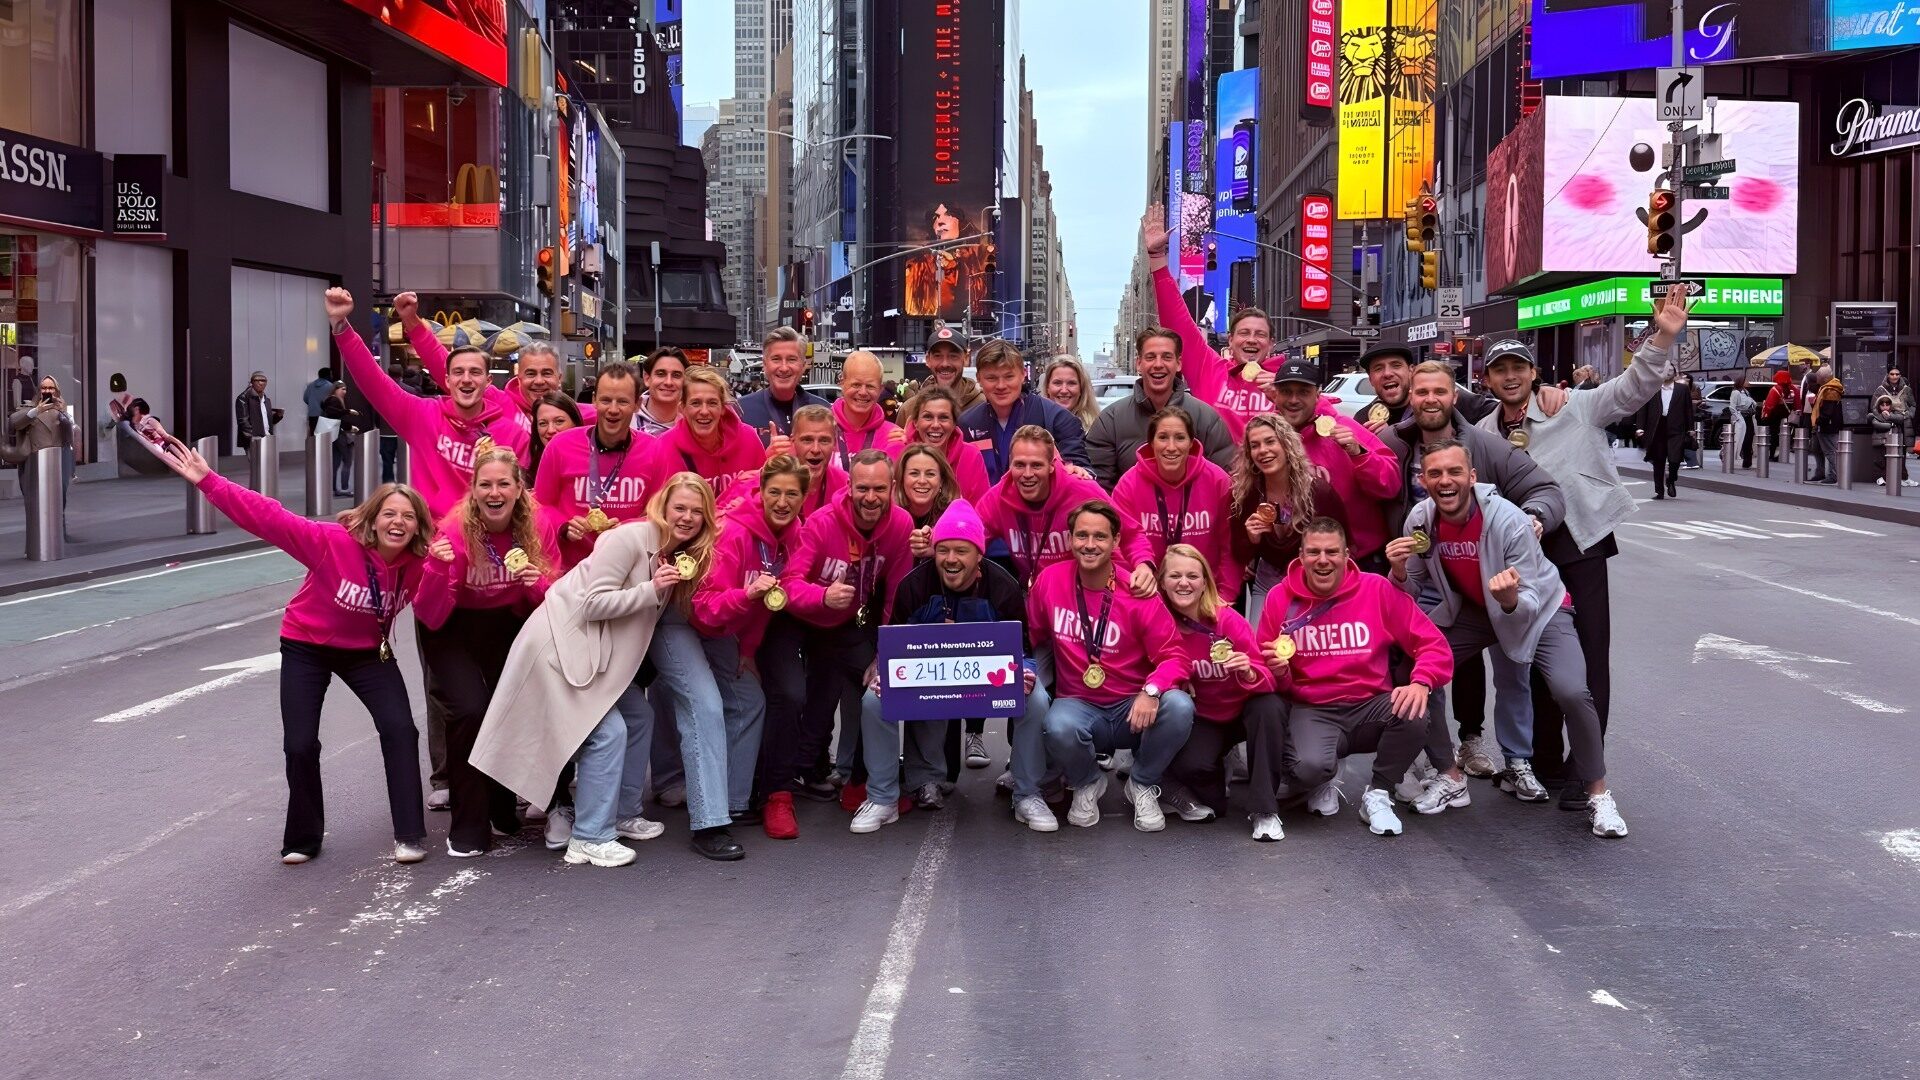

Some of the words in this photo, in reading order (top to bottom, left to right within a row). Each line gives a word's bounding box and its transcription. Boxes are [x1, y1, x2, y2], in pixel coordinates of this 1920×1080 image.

[937, 26, 951, 59] THE
[633, 33, 646, 94] 1500
[1663, 105, 1695, 117] ONLY
[936, 89, 951, 184] FLORENCE
[118, 183, 143, 194] U.S.
[117, 196, 156, 208] POLO
[117, 209, 159, 222] ASSN.
[1440, 305, 1461, 317] 25
[915, 662, 946, 681] 241
[953, 660, 981, 681] 688
